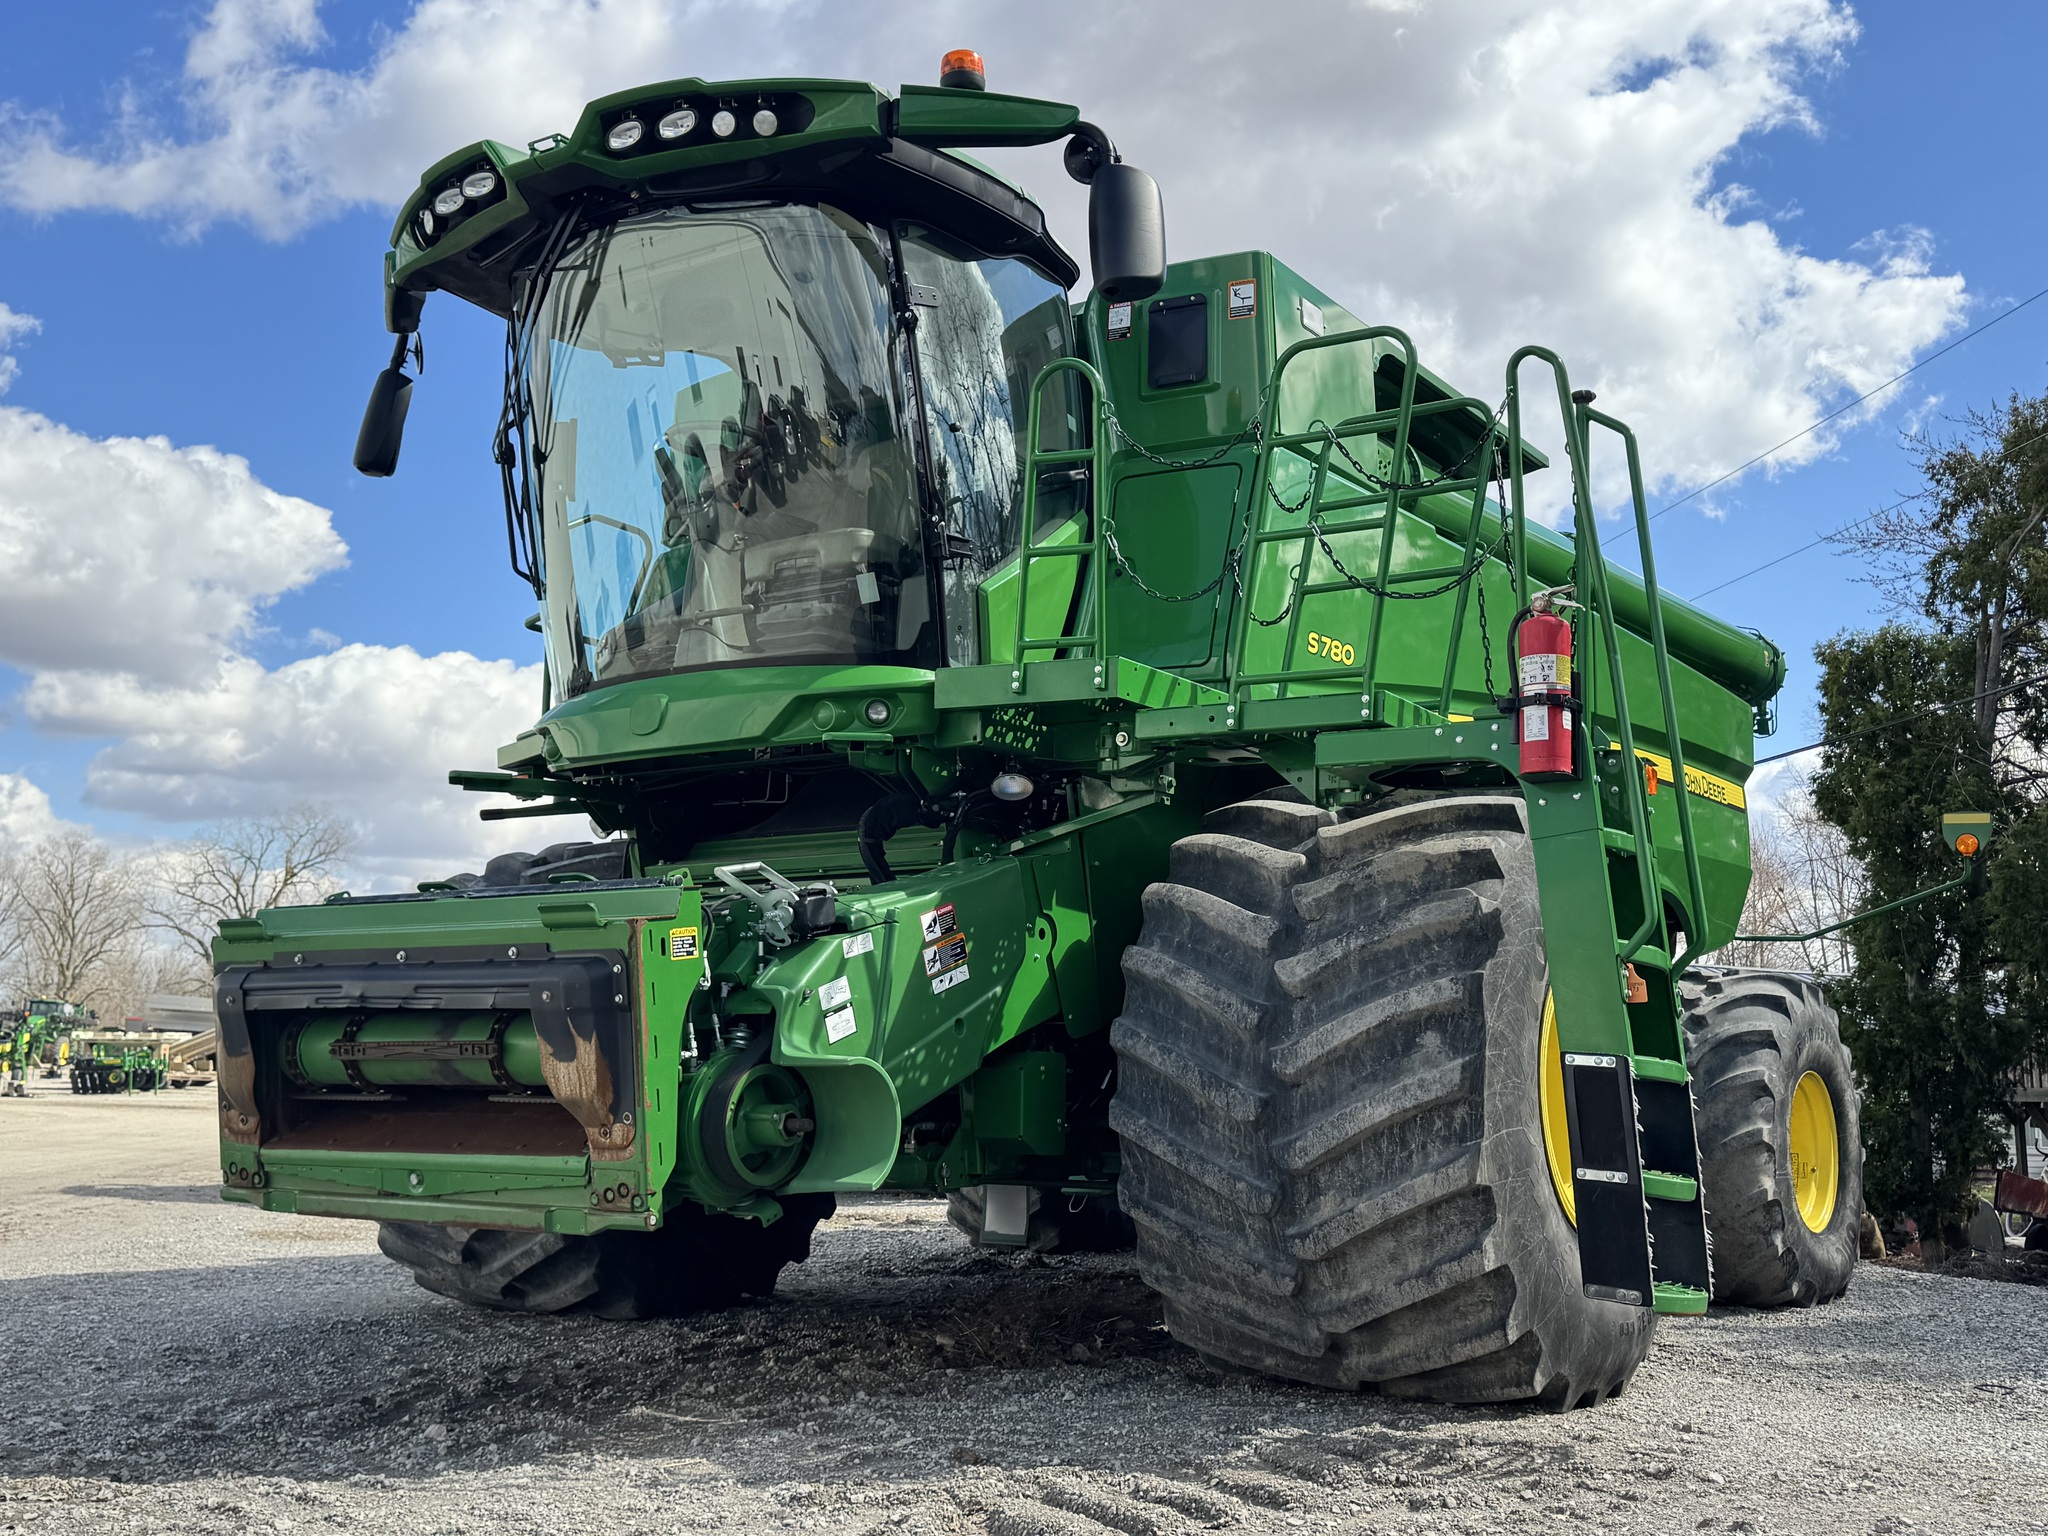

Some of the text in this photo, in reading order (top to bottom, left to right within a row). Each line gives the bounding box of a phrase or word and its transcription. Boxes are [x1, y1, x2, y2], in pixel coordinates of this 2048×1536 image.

[1307, 631, 1355, 666] S780
[1684, 772, 1727, 803] OHN DEERE
[675, 928, 697, 936] CAUTION
